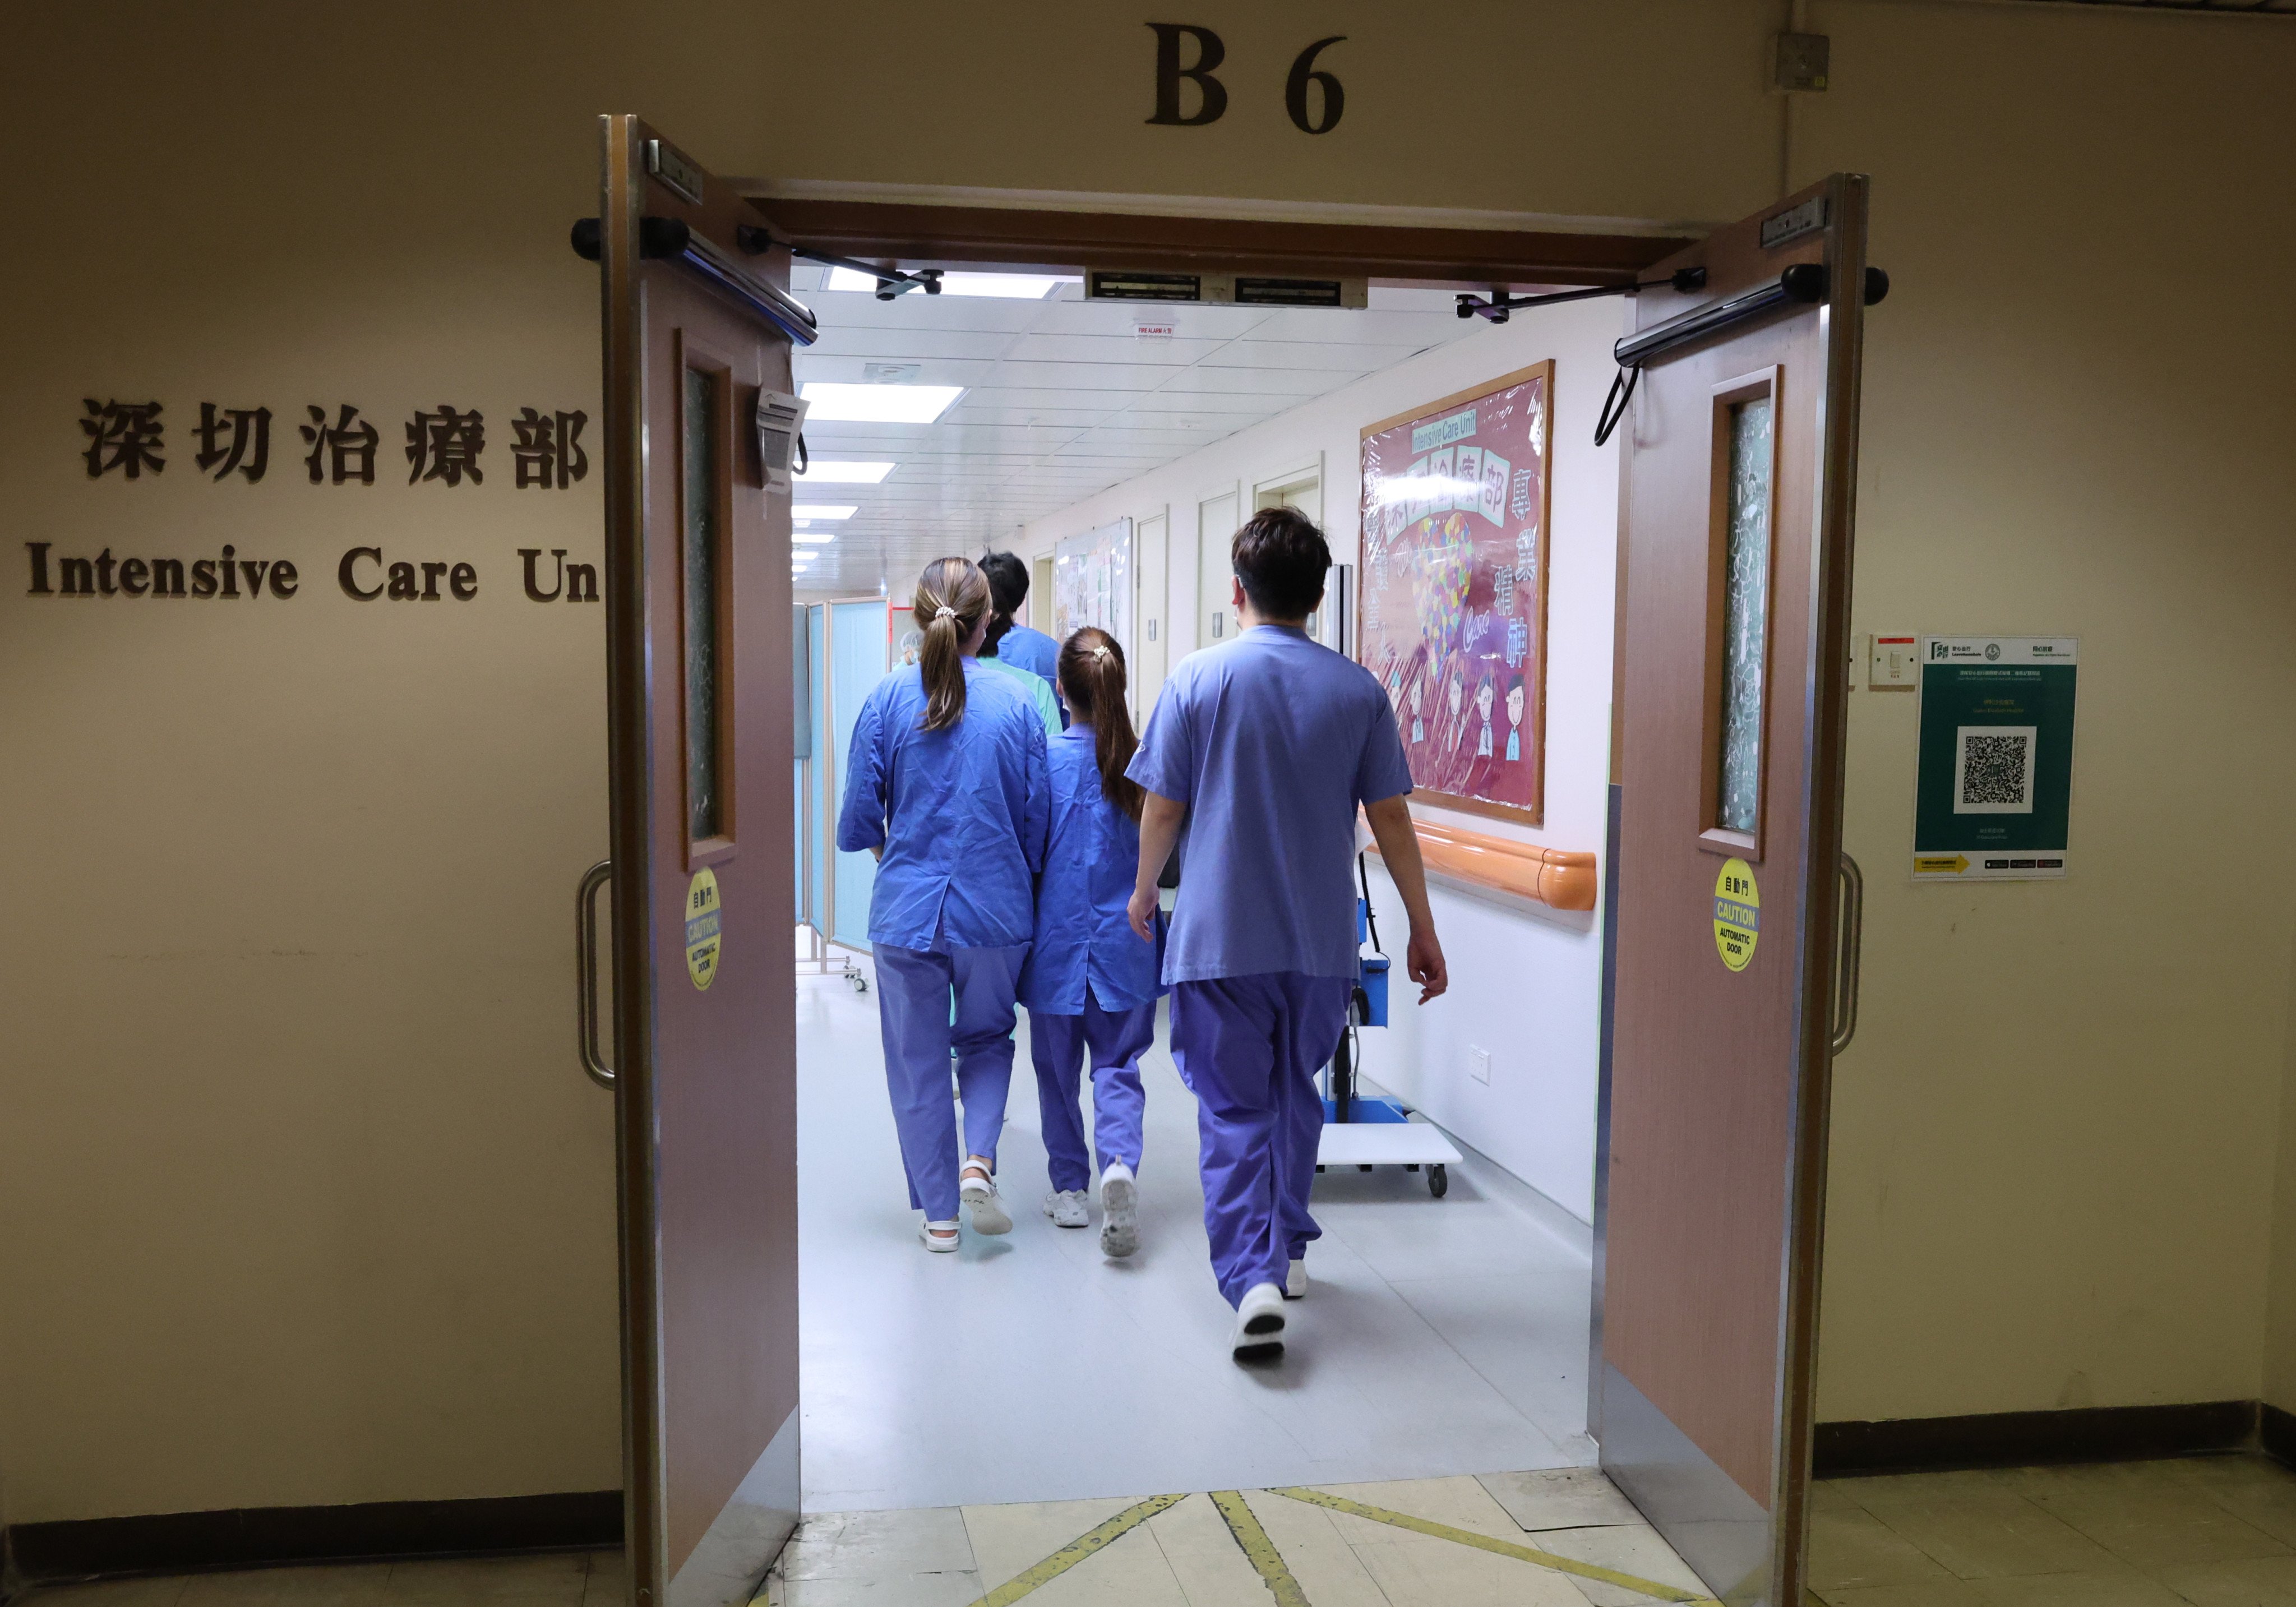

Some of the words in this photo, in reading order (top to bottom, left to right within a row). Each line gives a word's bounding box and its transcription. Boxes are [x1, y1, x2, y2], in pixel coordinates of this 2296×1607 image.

[1144, 22, 1227, 126] B
[1286, 36, 1347, 135] 6
[1413, 424, 1442, 451] Intensive
[1443, 421, 1458, 441] Care
[1461, 412, 1475, 435] Unit
[80, 399, 589, 489] 深切治療部
[25, 542, 299, 600] Intensive
[338, 547, 478, 602] Care
[1726, 876, 1748, 896] 自動門
[1717, 901, 1756, 927] CAUTION
[1720, 927, 1750, 945] AUTOMATIC
[692, 943, 716, 962] AUTOMATIC
[1726, 942, 1742, 955] DOOR
[698, 959, 710, 973] DOOR
